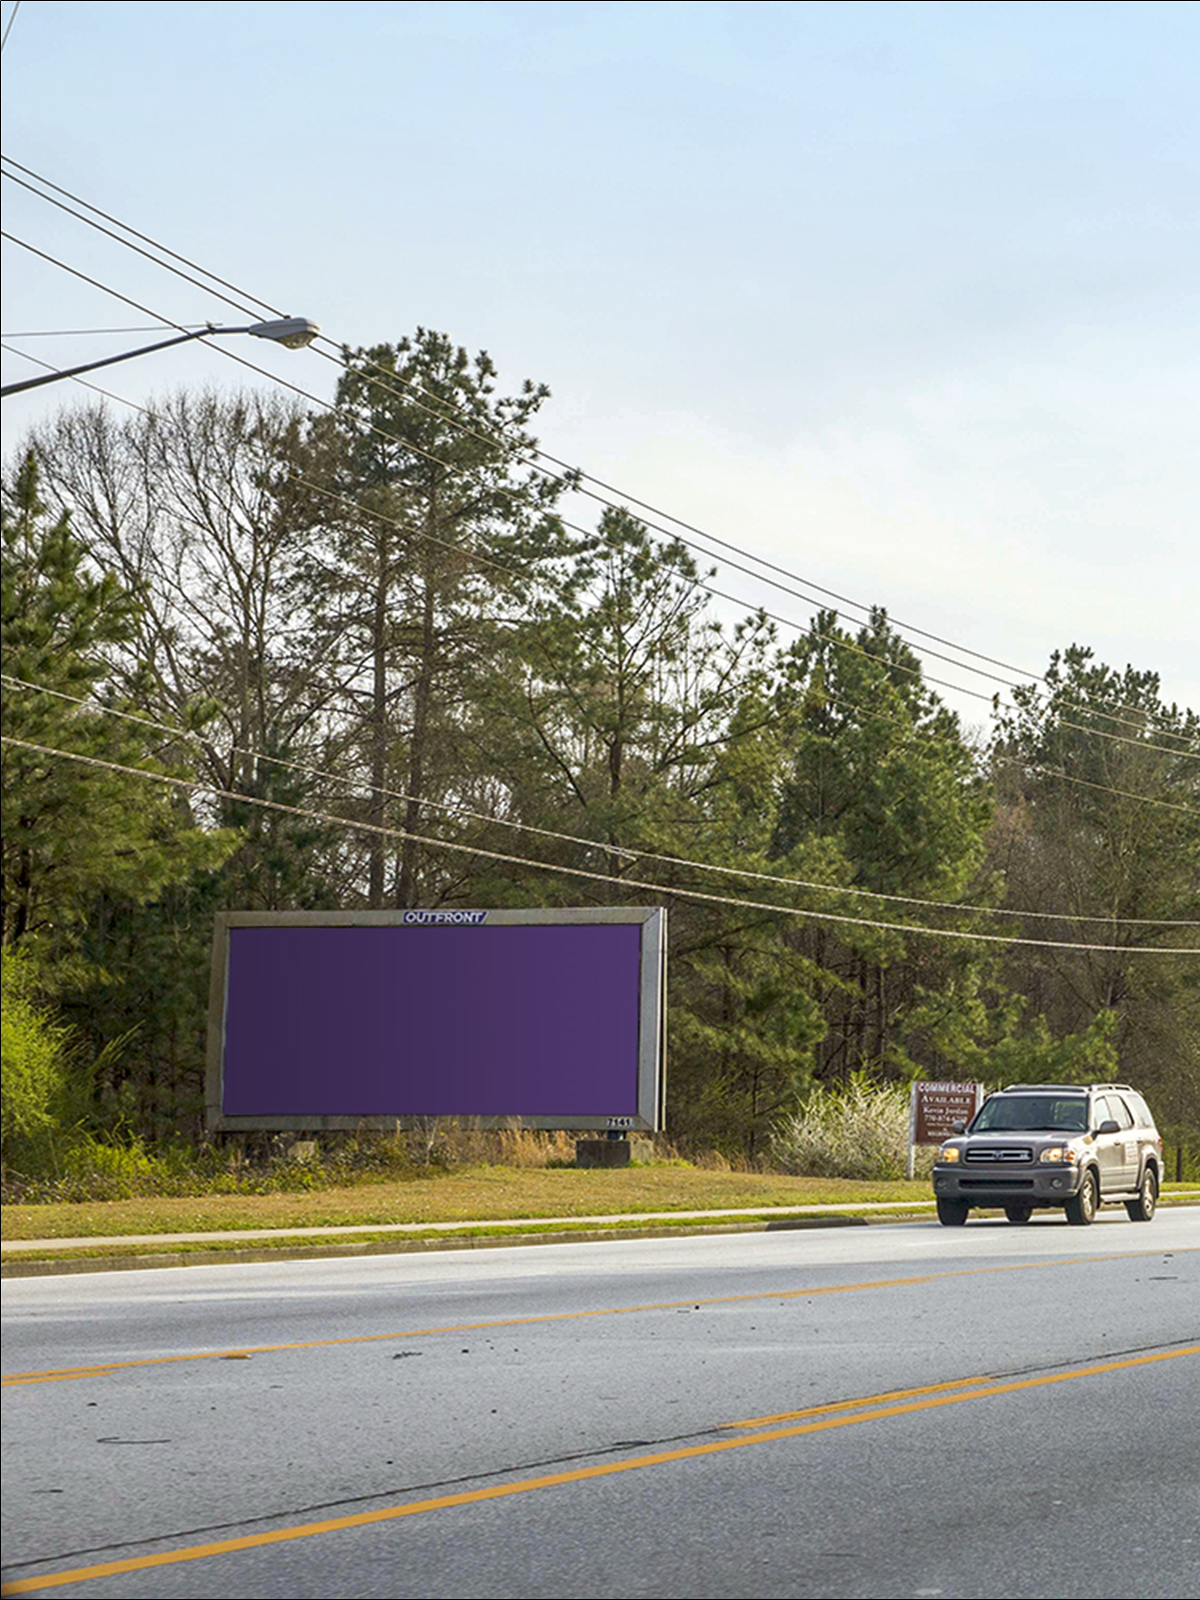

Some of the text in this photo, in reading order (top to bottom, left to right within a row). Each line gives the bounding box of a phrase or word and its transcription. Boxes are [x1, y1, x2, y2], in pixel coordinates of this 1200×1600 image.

[406, 912, 483, 923] OUTFRONT
[918, 1083, 975, 1093] COMMERCIAL
[921, 1095, 971, 1104] AVAILABLE
[607, 1116, 631, 1128] 7141
